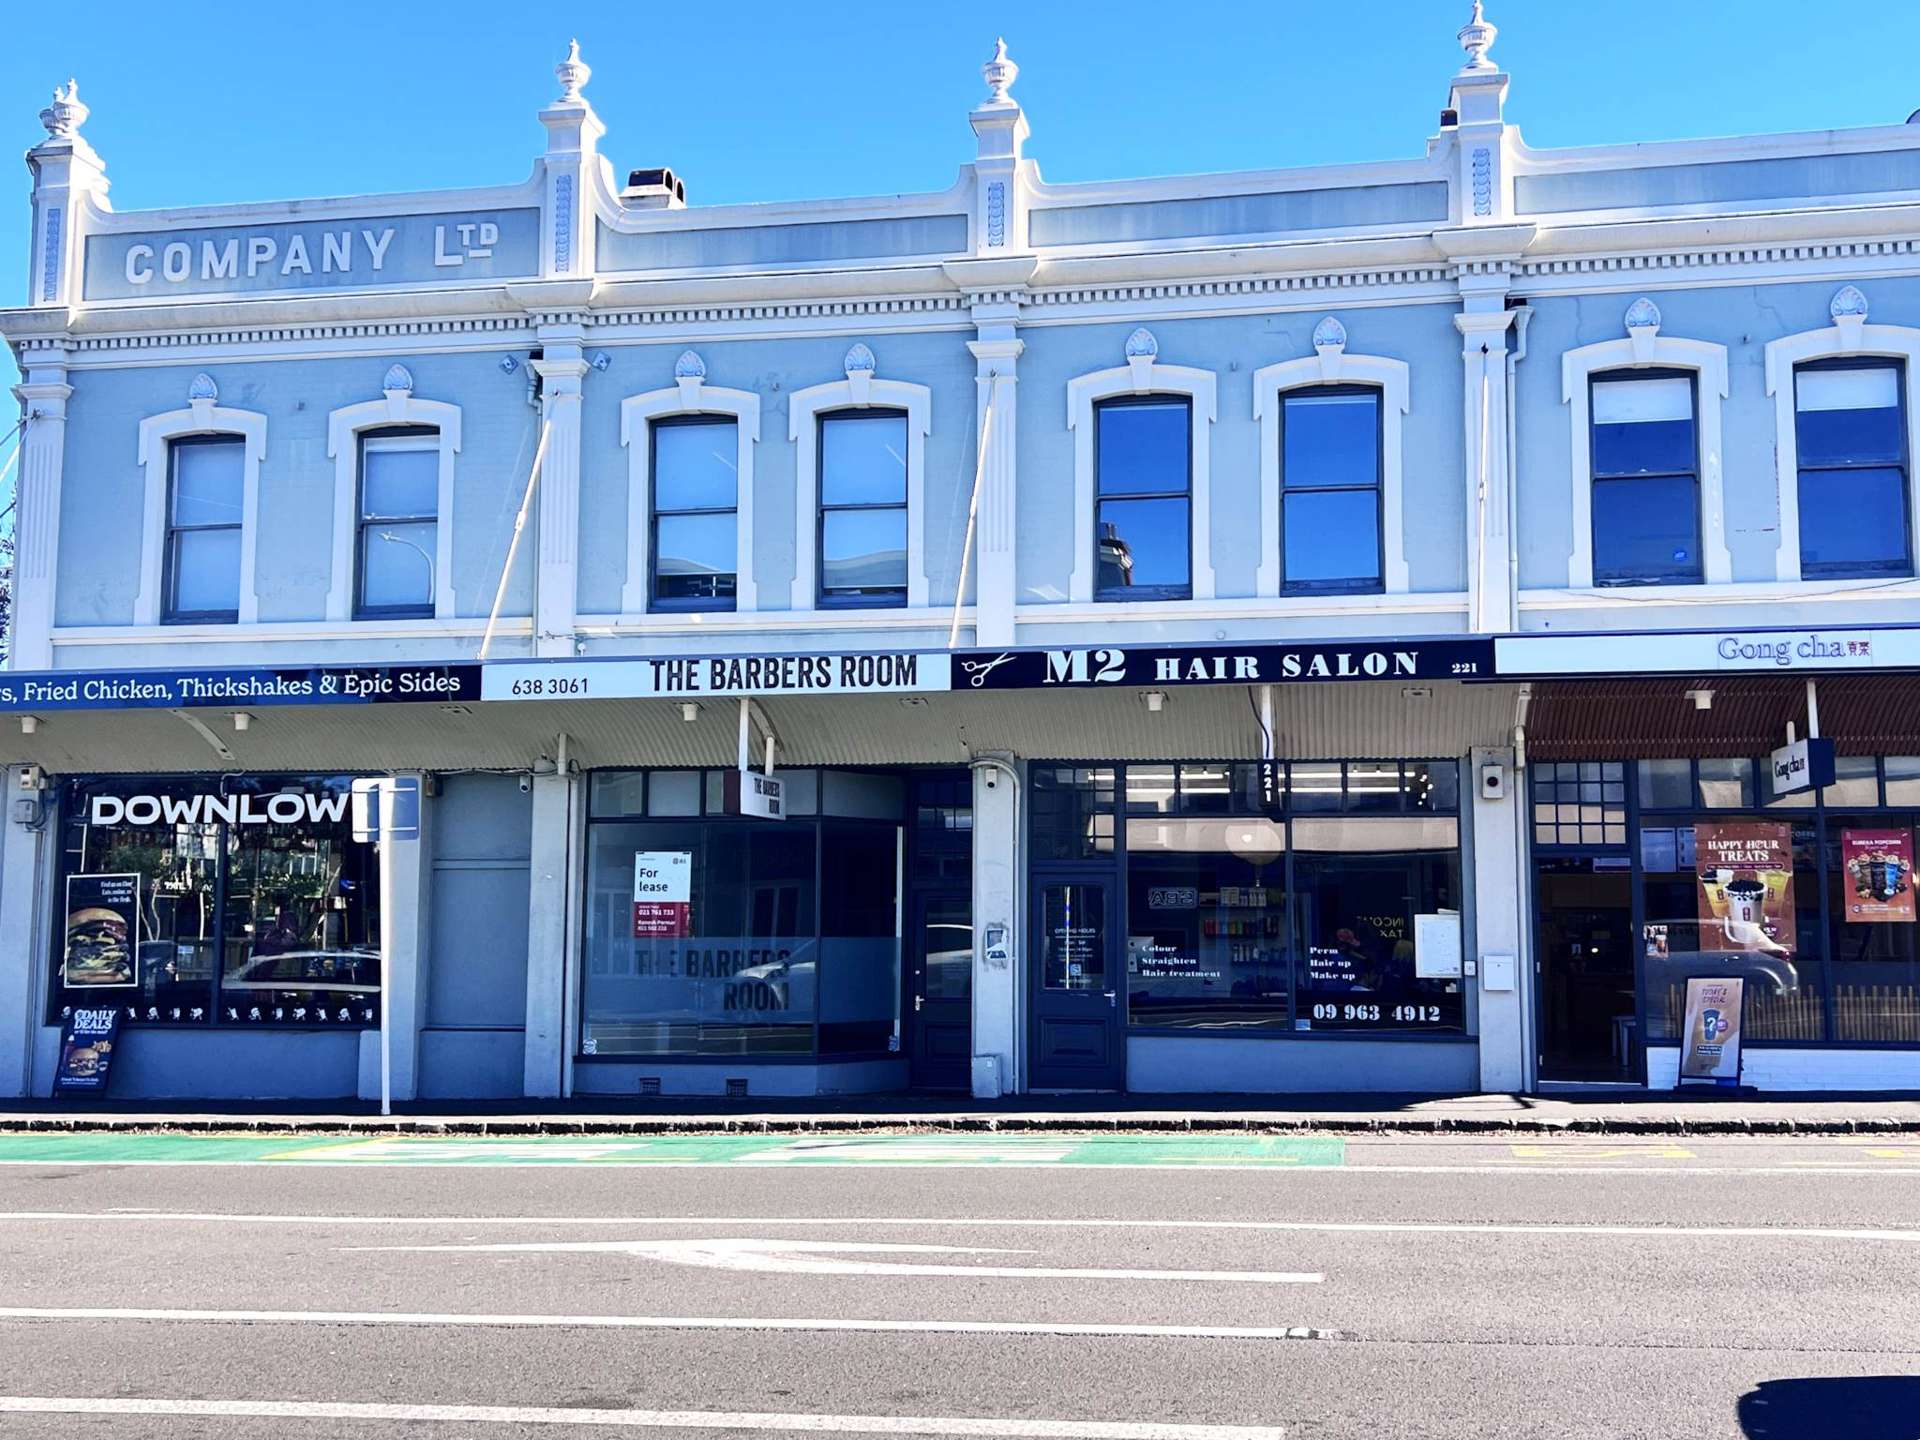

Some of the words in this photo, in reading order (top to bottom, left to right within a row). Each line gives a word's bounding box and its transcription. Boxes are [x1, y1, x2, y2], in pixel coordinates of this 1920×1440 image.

[125, 228, 396, 284] COMPANY
[1718, 637, 1791, 666] Gong
[1797, 635, 1846, 658] cha
[1042, 649, 1127, 684] M2
[1154, 655, 1261, 682] HAIR
[1281, 651, 1420, 678] SALON
[1451, 662, 1478, 674] 221
[511, 679, 543, 695] 638
[548, 677, 589, 694] 3061
[650, 659, 700, 692] THE
[710, 656, 831, 691] BARBERS
[839, 654, 917, 689] ROOM
[0, 687, 18, 704] s,
[24, 680, 77, 701] Fried
[83, 677, 173, 700] Chicken,
[177, 674, 313, 698] Thickshakes
[319, 674, 338, 695] &
[343, 673, 393, 696] Epic
[399, 671, 461, 693] Sides
[1774, 760, 1790, 781] Gong
[1263, 763, 1272, 802] 221
[92, 792, 349, 825] DOWNLOW
[1707, 840, 1744, 850] HAPPY
[1746, 840, 1779, 850] HOUR
[1718, 850, 1769, 862] TREATS
[639, 868, 659, 878] For
[639, 881, 669, 892] lease
[1309, 947, 1338, 955] Perm
[1142, 957, 1197, 966] Straighten
[1310, 959, 1335, 967] Hair
[1338, 960, 1351, 968] up
[1142, 969, 1166, 977] Hair
[1169, 970, 1221, 978] treatment
[1310, 971, 1339, 980] Make
[1342, 972, 1356, 981] up
[723, 982, 790, 1011] ROOM
[83, 1009, 117, 1020] DAILY
[1313, 1003, 1337, 1020] 09
[1343, 1004, 1380, 1021] 963
[1391, 1005, 1441, 1022] 4912
[74, 1020, 112, 1030] DEALS
